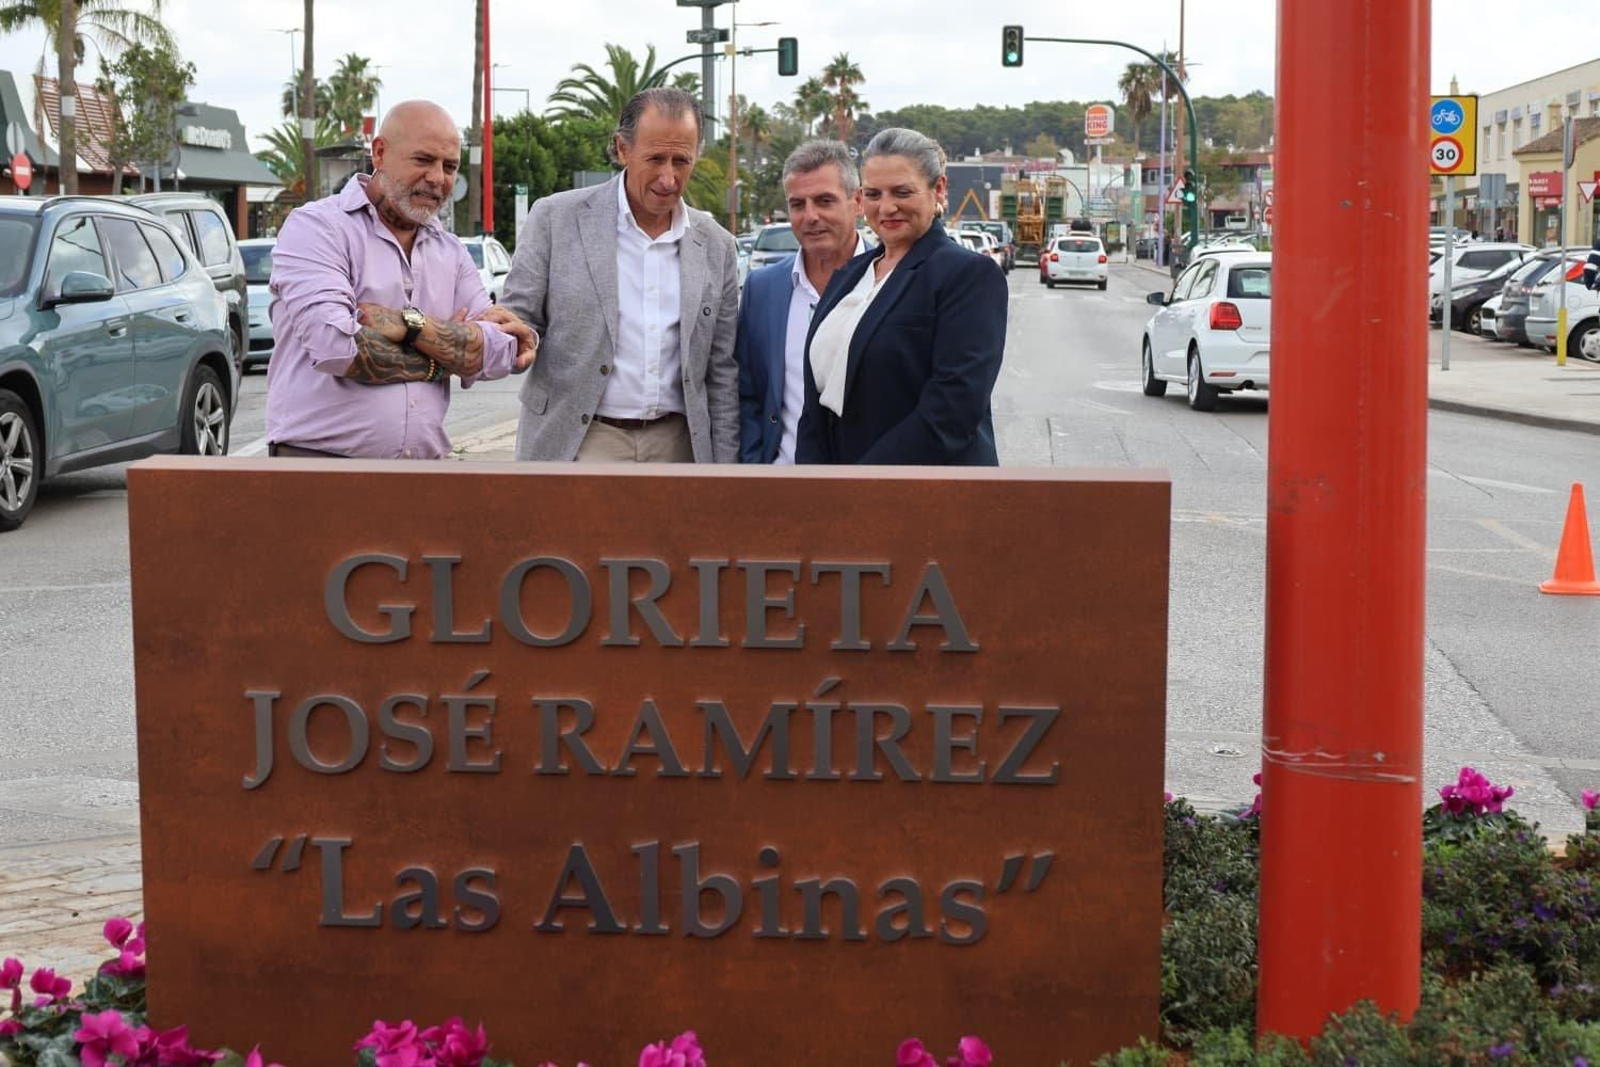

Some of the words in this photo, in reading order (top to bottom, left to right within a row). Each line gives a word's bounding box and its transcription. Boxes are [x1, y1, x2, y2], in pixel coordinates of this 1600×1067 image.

[1087, 121, 1108, 129] KING
[1435, 148, 1456, 161] 30
[324, 552, 980, 653] GLORIETA
[241, 669, 502, 790] JOSÉ
[531, 676, 1062, 786] RAMÍREZ
